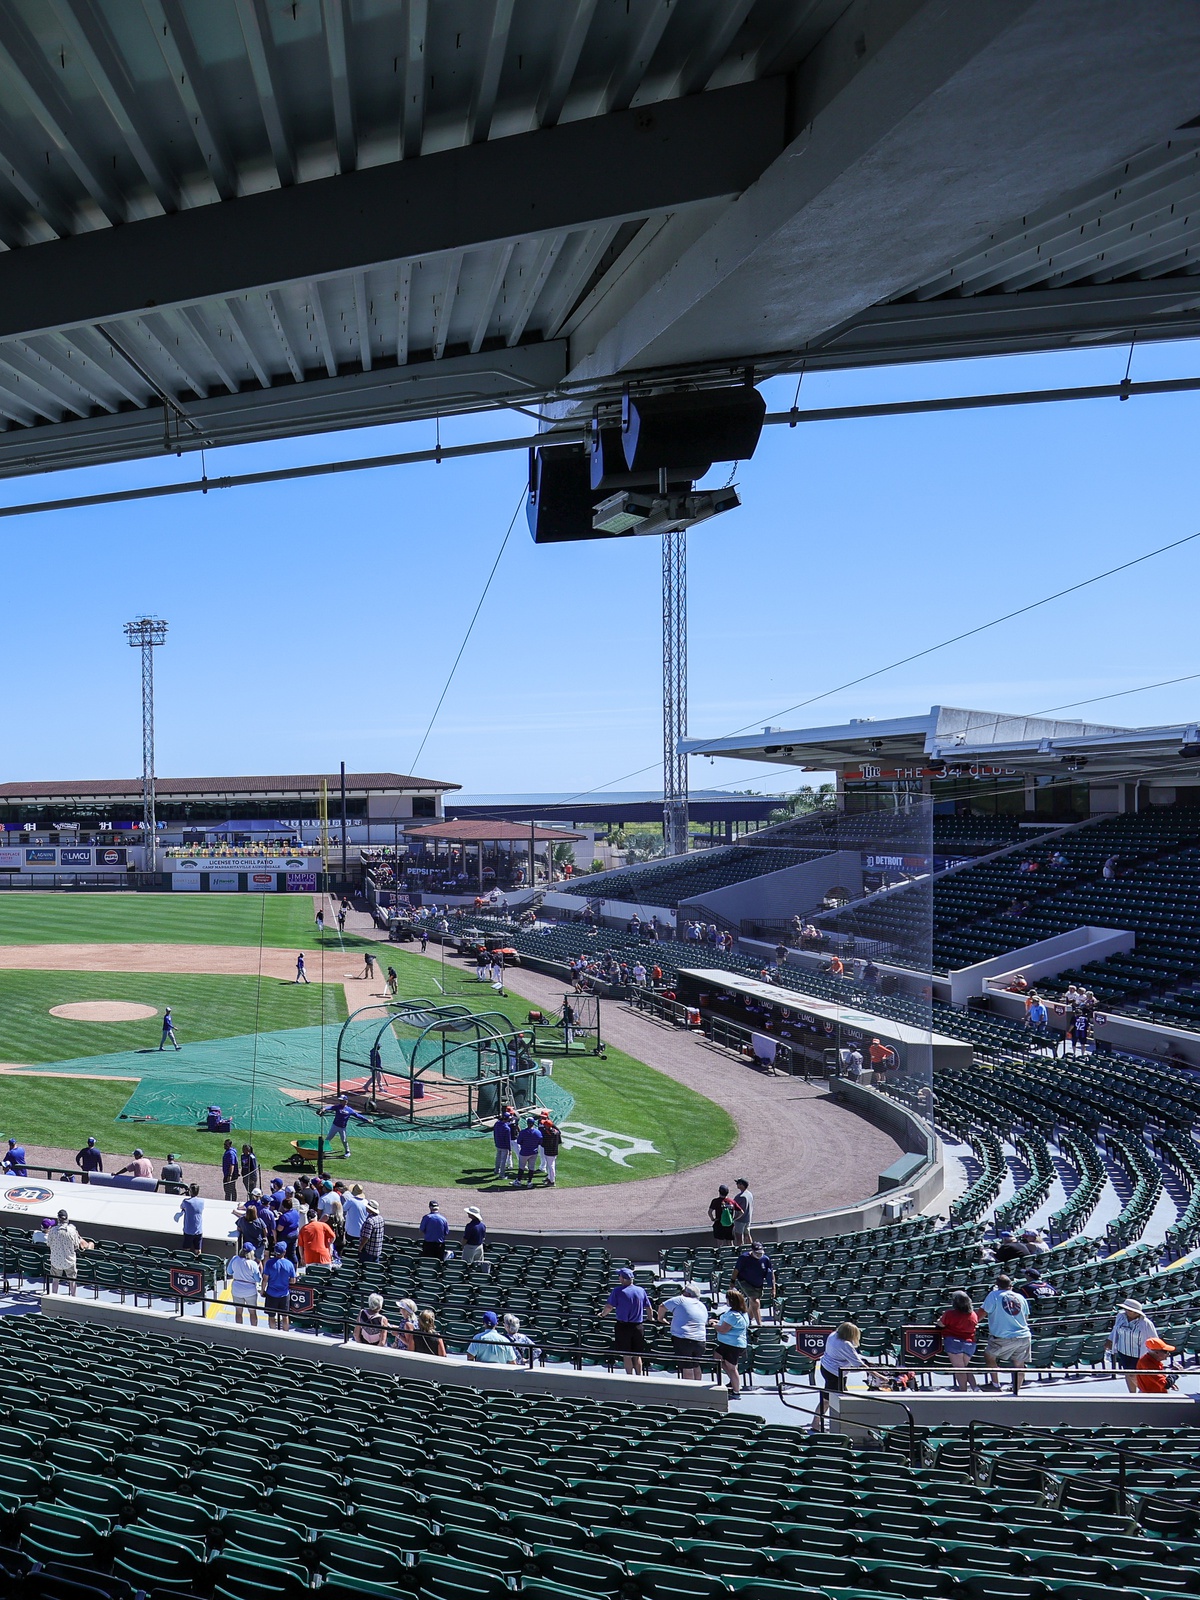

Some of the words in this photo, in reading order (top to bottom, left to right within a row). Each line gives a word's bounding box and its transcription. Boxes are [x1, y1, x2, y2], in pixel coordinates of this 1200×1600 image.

[861, 766, 881, 780] Lite
[894, 767, 924, 778] THE
[935, 766, 962, 779] 34
[67, 851, 90, 860] LMCU
[875, 855, 903, 866] DETROIT
[406, 867, 429, 875] PEPSI
[1075, 1022, 1086, 1031] 42
[177, 1277, 195, 1287] 109
[290, 1294, 306, 1303] 08
[804, 1339, 825, 1348] 108
[914, 1339, 934, 1348] 107
